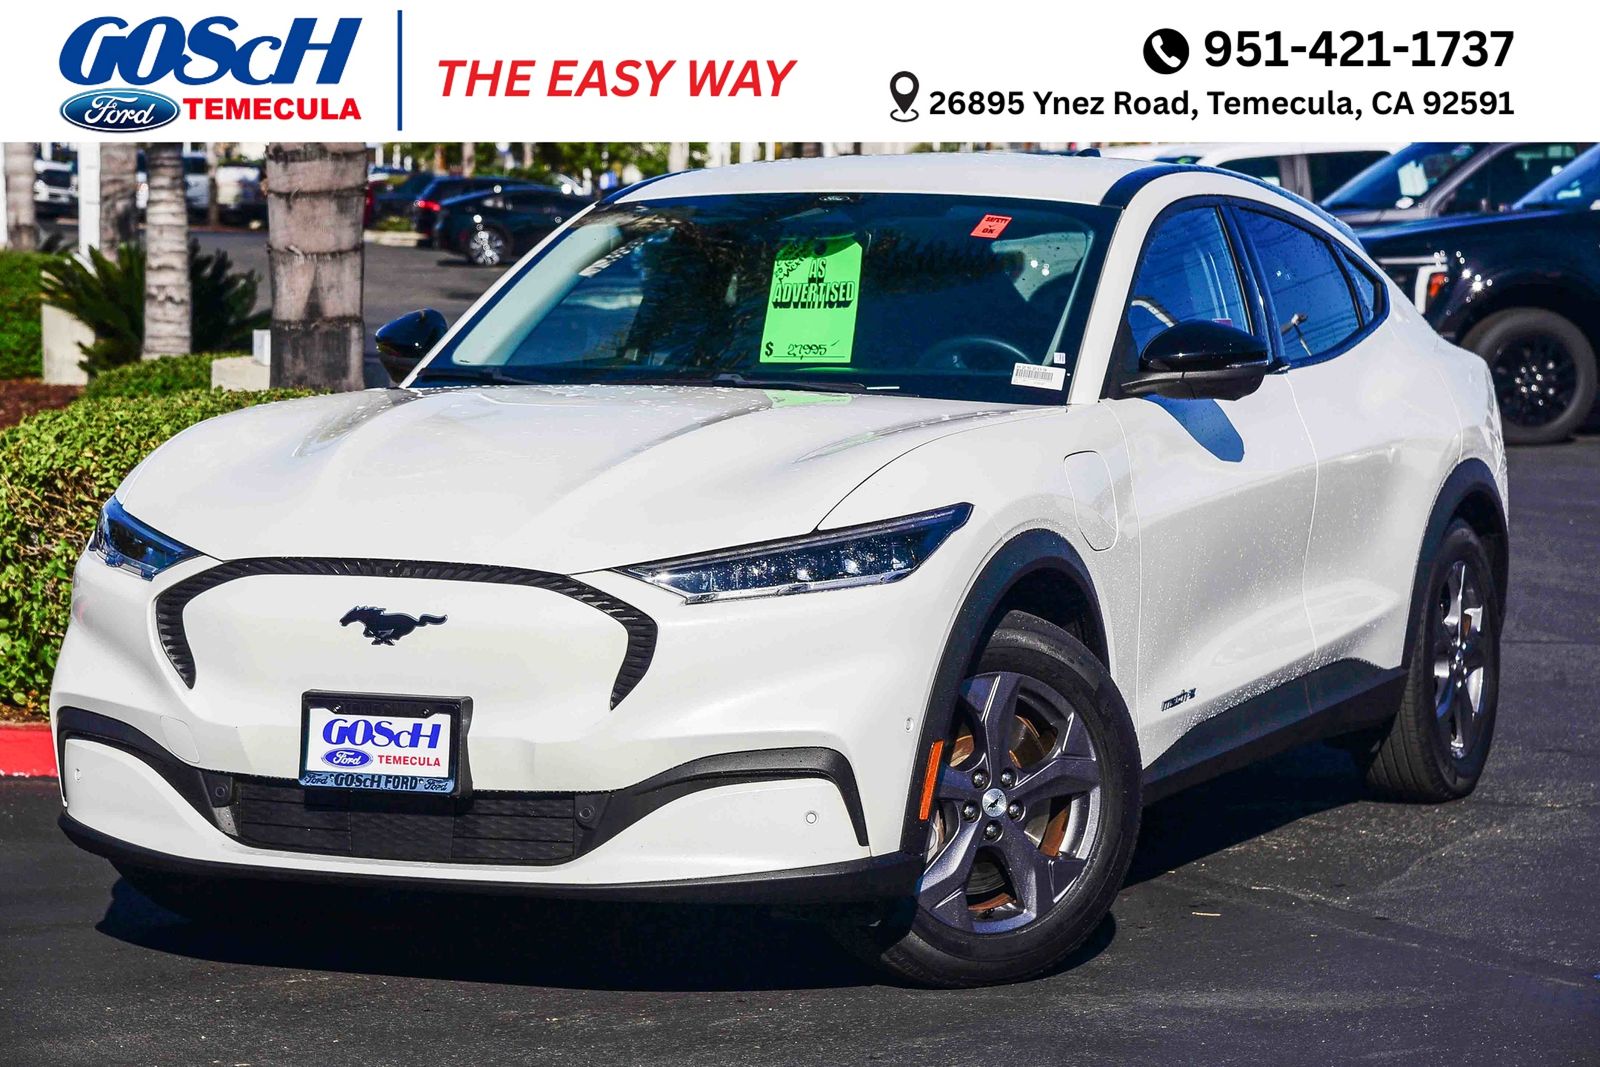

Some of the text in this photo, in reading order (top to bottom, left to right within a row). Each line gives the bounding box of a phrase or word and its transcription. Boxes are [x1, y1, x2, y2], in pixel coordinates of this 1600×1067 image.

[985, 216, 1010, 225] SAFETY
[808, 259, 827, 283] AS
[771, 281, 855, 309] ADVERTISED
[765, 341, 774, 357] $
[332, 750, 362, 765] Ford
[377, 754, 441, 767] TEMECULA
[304, 773, 329, 785] Ford
[384, 776, 419, 790] FORD
[424, 778, 448, 791] Ford
